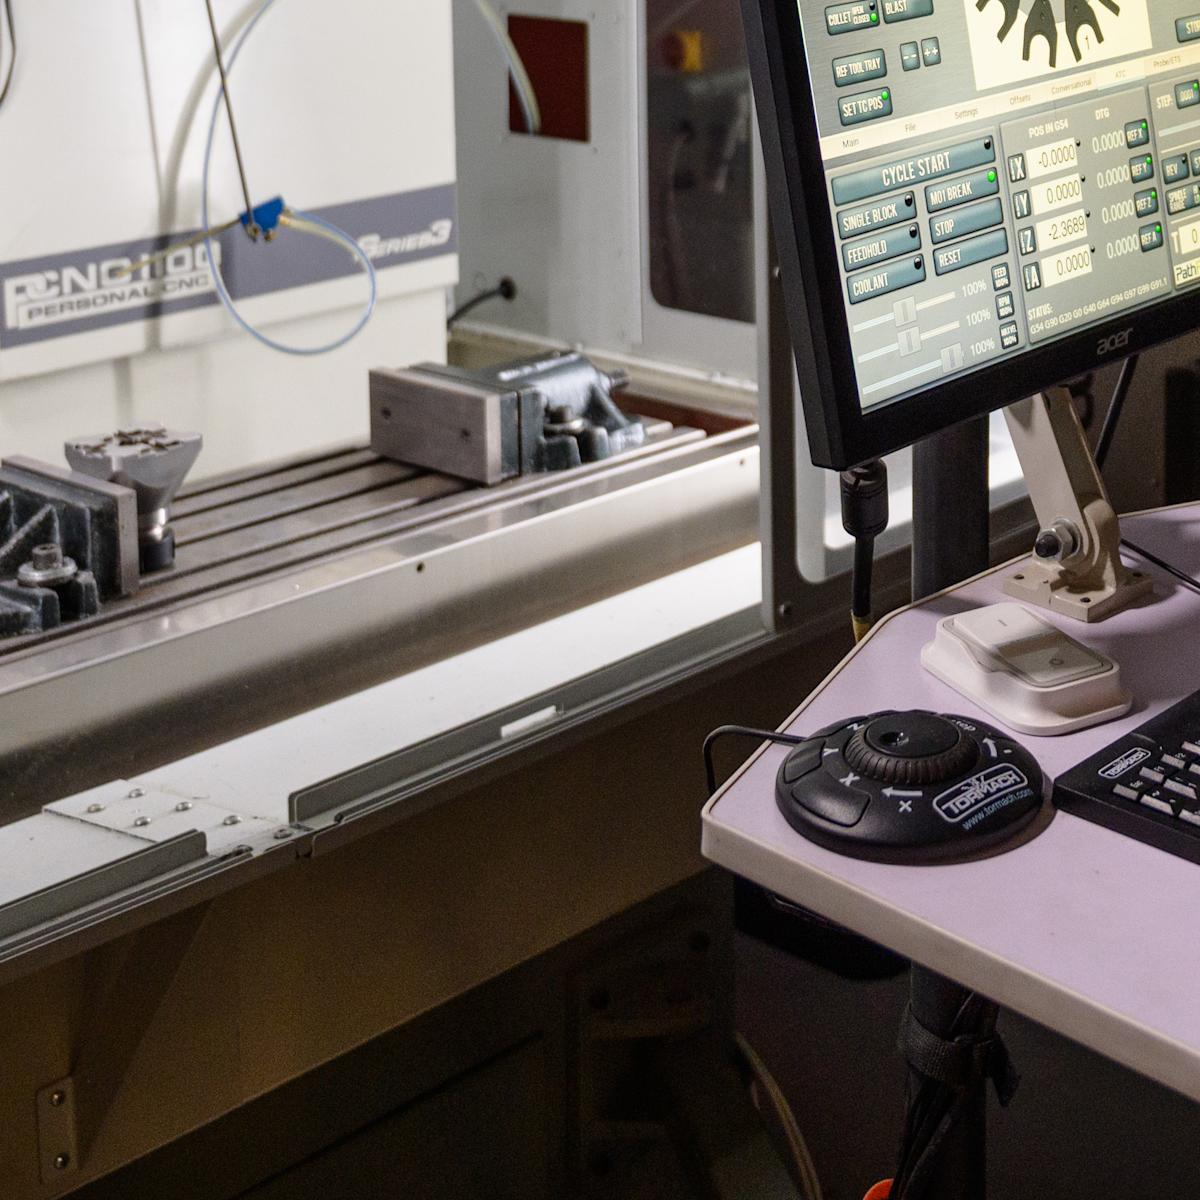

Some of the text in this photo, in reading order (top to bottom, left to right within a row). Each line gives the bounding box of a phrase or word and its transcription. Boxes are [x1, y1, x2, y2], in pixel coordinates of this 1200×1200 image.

[885, 0, 908, 14] BLAST
[828, 10, 852, 27] COLLET
[836, 57, 881, 78] REF TOOL TRAY
[842, 96, 884, 117] SET TC POS
[842, 138, 859, 148] Main
[905, 123, 916, 133] File
[954, 108, 978, 120] Settings
[1010, 94, 1031, 105] Offsets
[1051, 79, 1092, 95] Conversational
[1094, 108, 1110, 120] DTG
[1028, 125, 1045, 139] POS
[1045, 123, 1054, 135] IN
[1038, 144, 1075, 168] -0.0000
[1092, 130, 1124, 154] 0.0000
[881, 151, 950, 187] CYCLE START
[947, 182, 972, 201] BREAK
[1046, 180, 1080, 204] 0.0000
[1097, 164, 1130, 189] 0.0000
[843, 204, 898, 231] SINGLE BLOCK
[934, 219, 955, 237] STOP
[1048, 215, 1085, 240] -2.3689
[1102, 199, 1135, 224] 0.0000
[848, 240, 887, 264] FEEDHOLD
[1171, 228, 1198, 254] T 0
[938, 248, 961, 268] RESET
[1056, 252, 1091, 276] 0.0000
[1106, 234, 1140, 259] 0.0000
[994, 266, 1007, 279] FEED
[852, 272, 889, 296] COOLANT
[962, 280, 987, 297] 100%
[27, 285, 155, 320] PERSONAL
[1027, 303, 1054, 321] STATUS:
[1030, 324, 1044, 335] G54
[1058, 312, 1072, 324] G20
[1072, 308, 1082, 319] G0
[1083, 304, 1096, 316] G40
[1123, 288, 1136, 300] G97
[966, 308, 991, 327] 100%
[970, 337, 995, 356] 100%
[1097, 328, 1133, 356] acer
[839, 772, 860, 787] X
[941, 770, 1021, 814] TORMACH
[962, 788, 1034, 831] www.tormach.com
